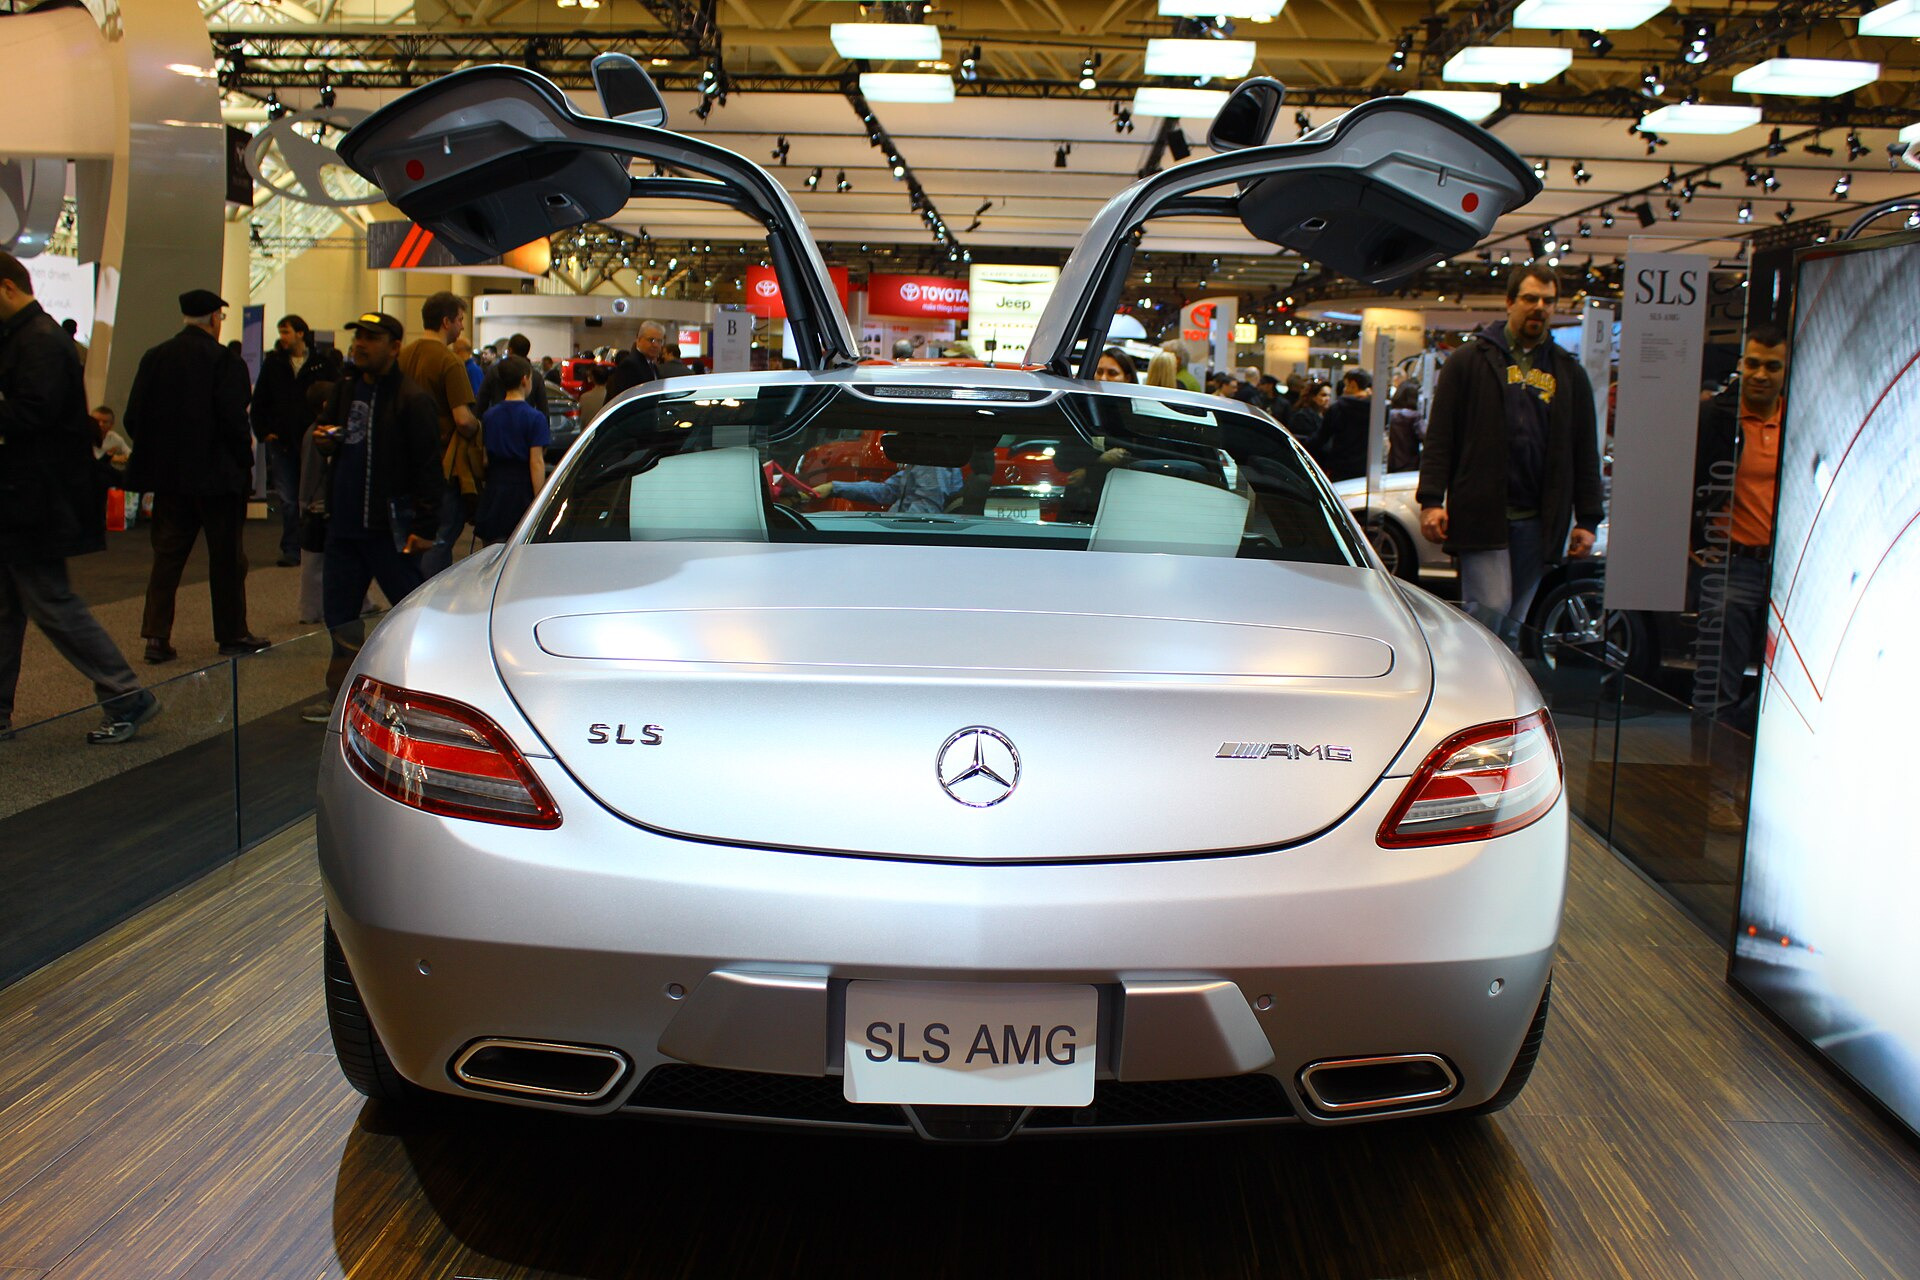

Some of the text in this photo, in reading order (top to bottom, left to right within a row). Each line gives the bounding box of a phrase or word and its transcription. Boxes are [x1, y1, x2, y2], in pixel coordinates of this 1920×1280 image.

[921, 285, 969, 303] TOYOTA
[1635, 269, 1698, 306] SLS
[996, 296, 1031, 311] Jeep
[727, 319, 737, 336] B
[587, 723, 665, 746] SLS
[1260, 742, 1353, 762] AMG
[865, 1021, 1077, 1067] SLS AMG
